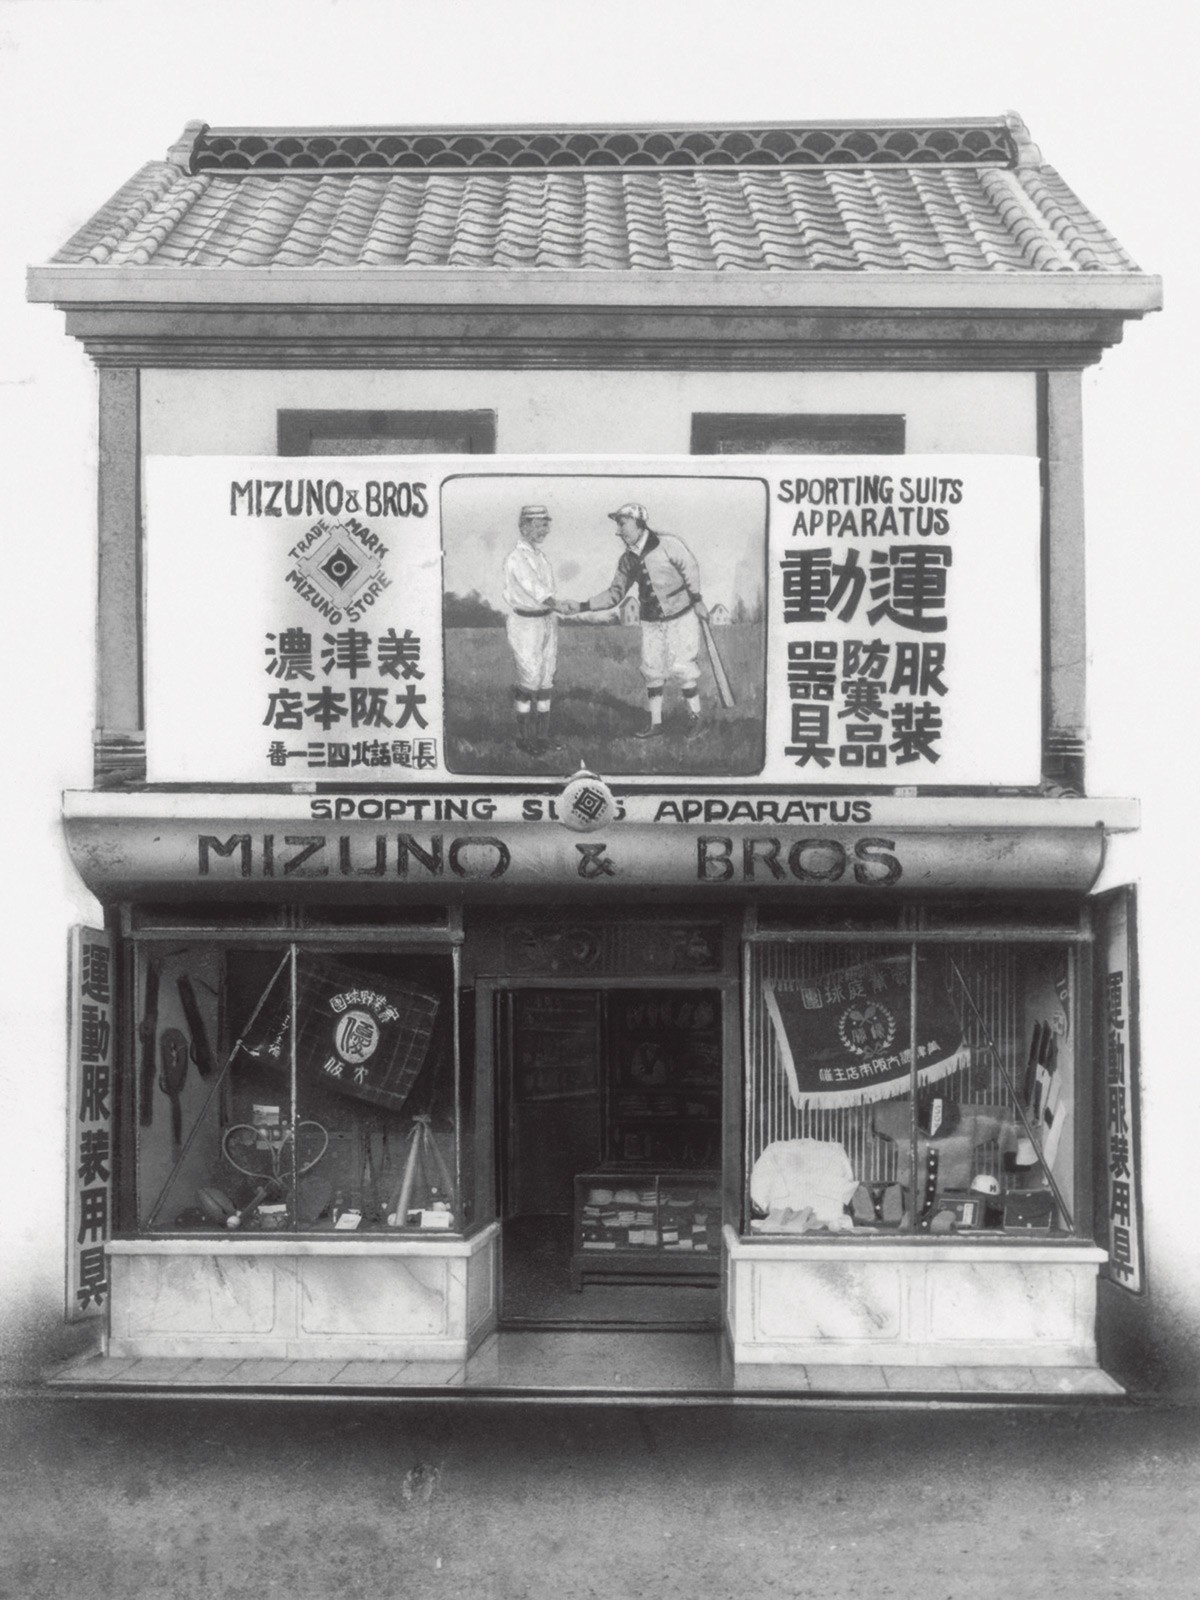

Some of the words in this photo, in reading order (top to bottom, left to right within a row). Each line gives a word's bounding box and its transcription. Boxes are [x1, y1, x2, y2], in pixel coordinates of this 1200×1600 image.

[777, 475, 893, 506] SPORTING
[900, 477, 963, 504] SUITS
[288, 519, 330, 559] TRADE
[345, 517, 389, 559] MARK
[792, 506, 950, 537] APPARATUS
[285, 570, 342, 625] MIZUNO
[346, 571, 393, 623] STORE
[653, 799, 872, 823] APPARATUS
[198, 834, 512, 879] MIZUNO
[575, 843, 616, 879] &
[698, 834, 904, 884] BROS
